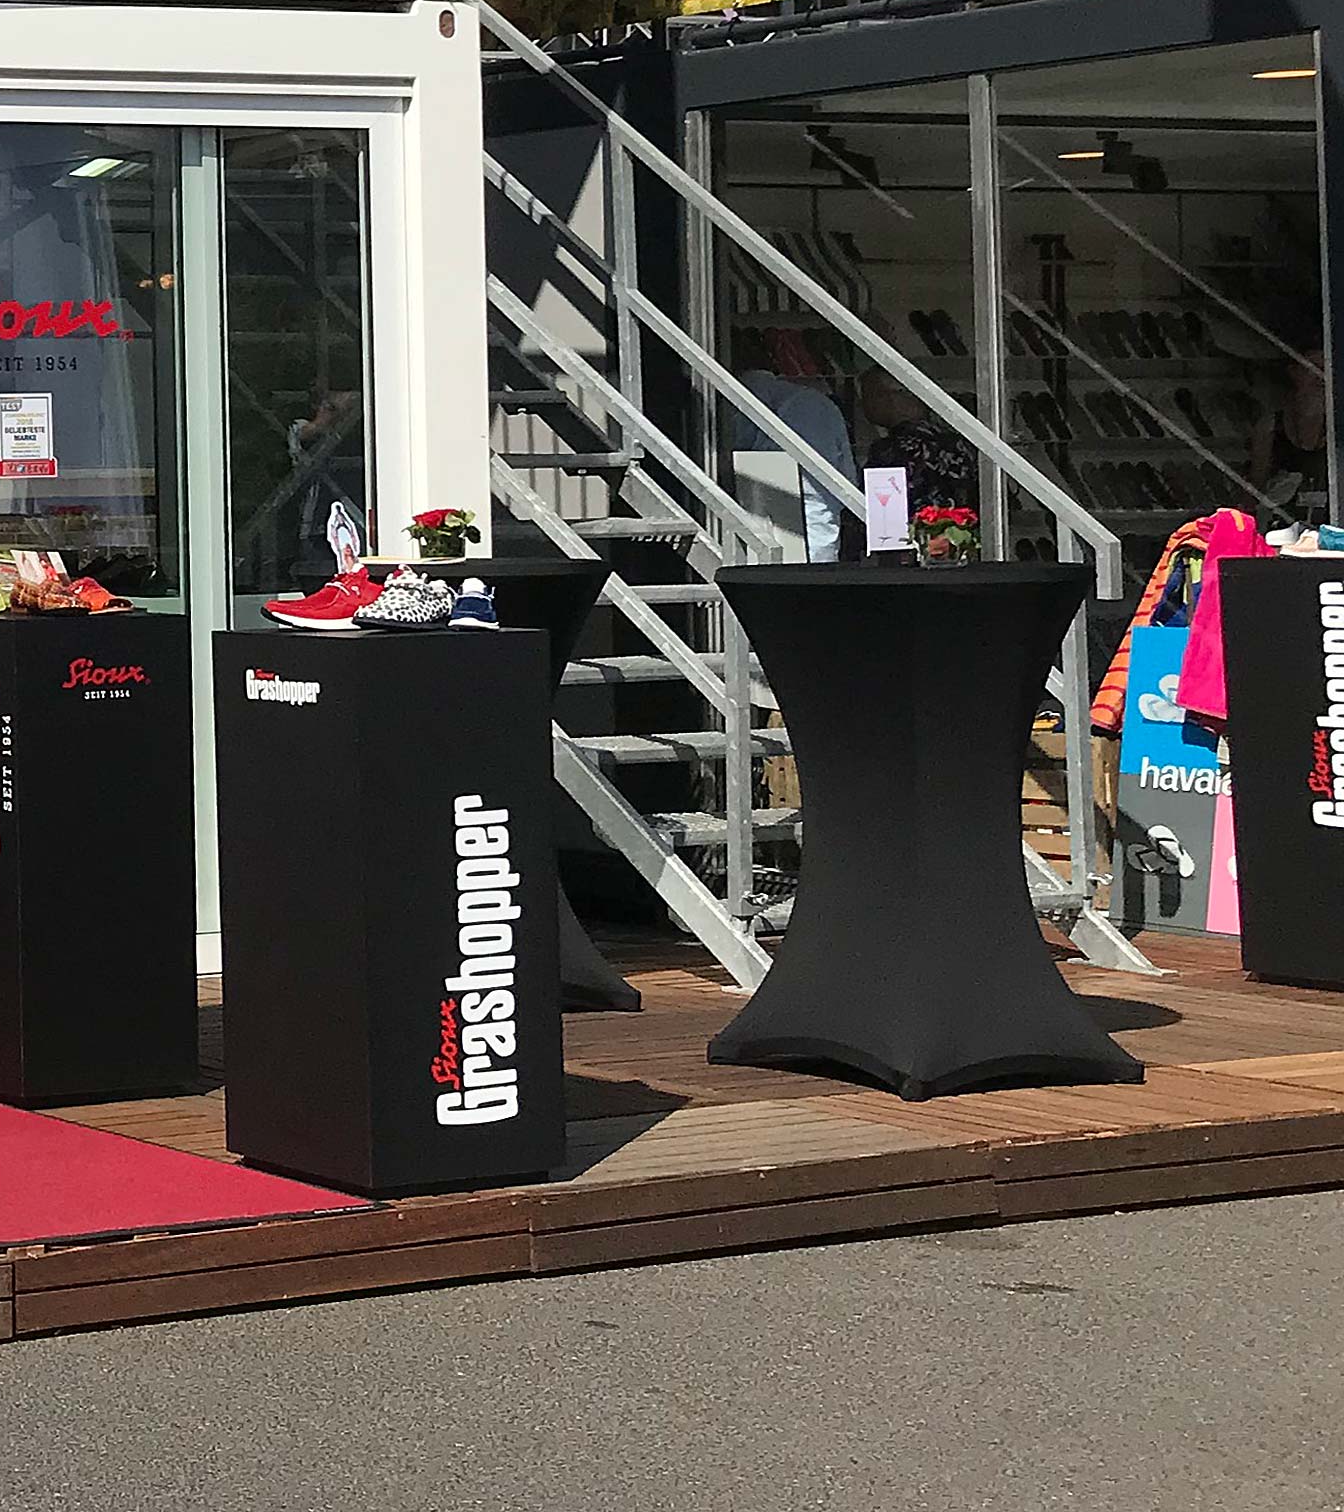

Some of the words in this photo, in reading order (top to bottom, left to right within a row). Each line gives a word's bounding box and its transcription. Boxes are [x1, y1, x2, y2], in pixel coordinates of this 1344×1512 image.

[35, 356, 78, 372] 1954
[62, 657, 146, 688] Sioux
[246, 669, 321, 706] Grashopper
[2, 714, 12, 756] 1954
[2, 765, 13, 812] SEIT
[436, 794, 522, 1126] Grashopper
[431, 998, 460, 1090] Sioux
